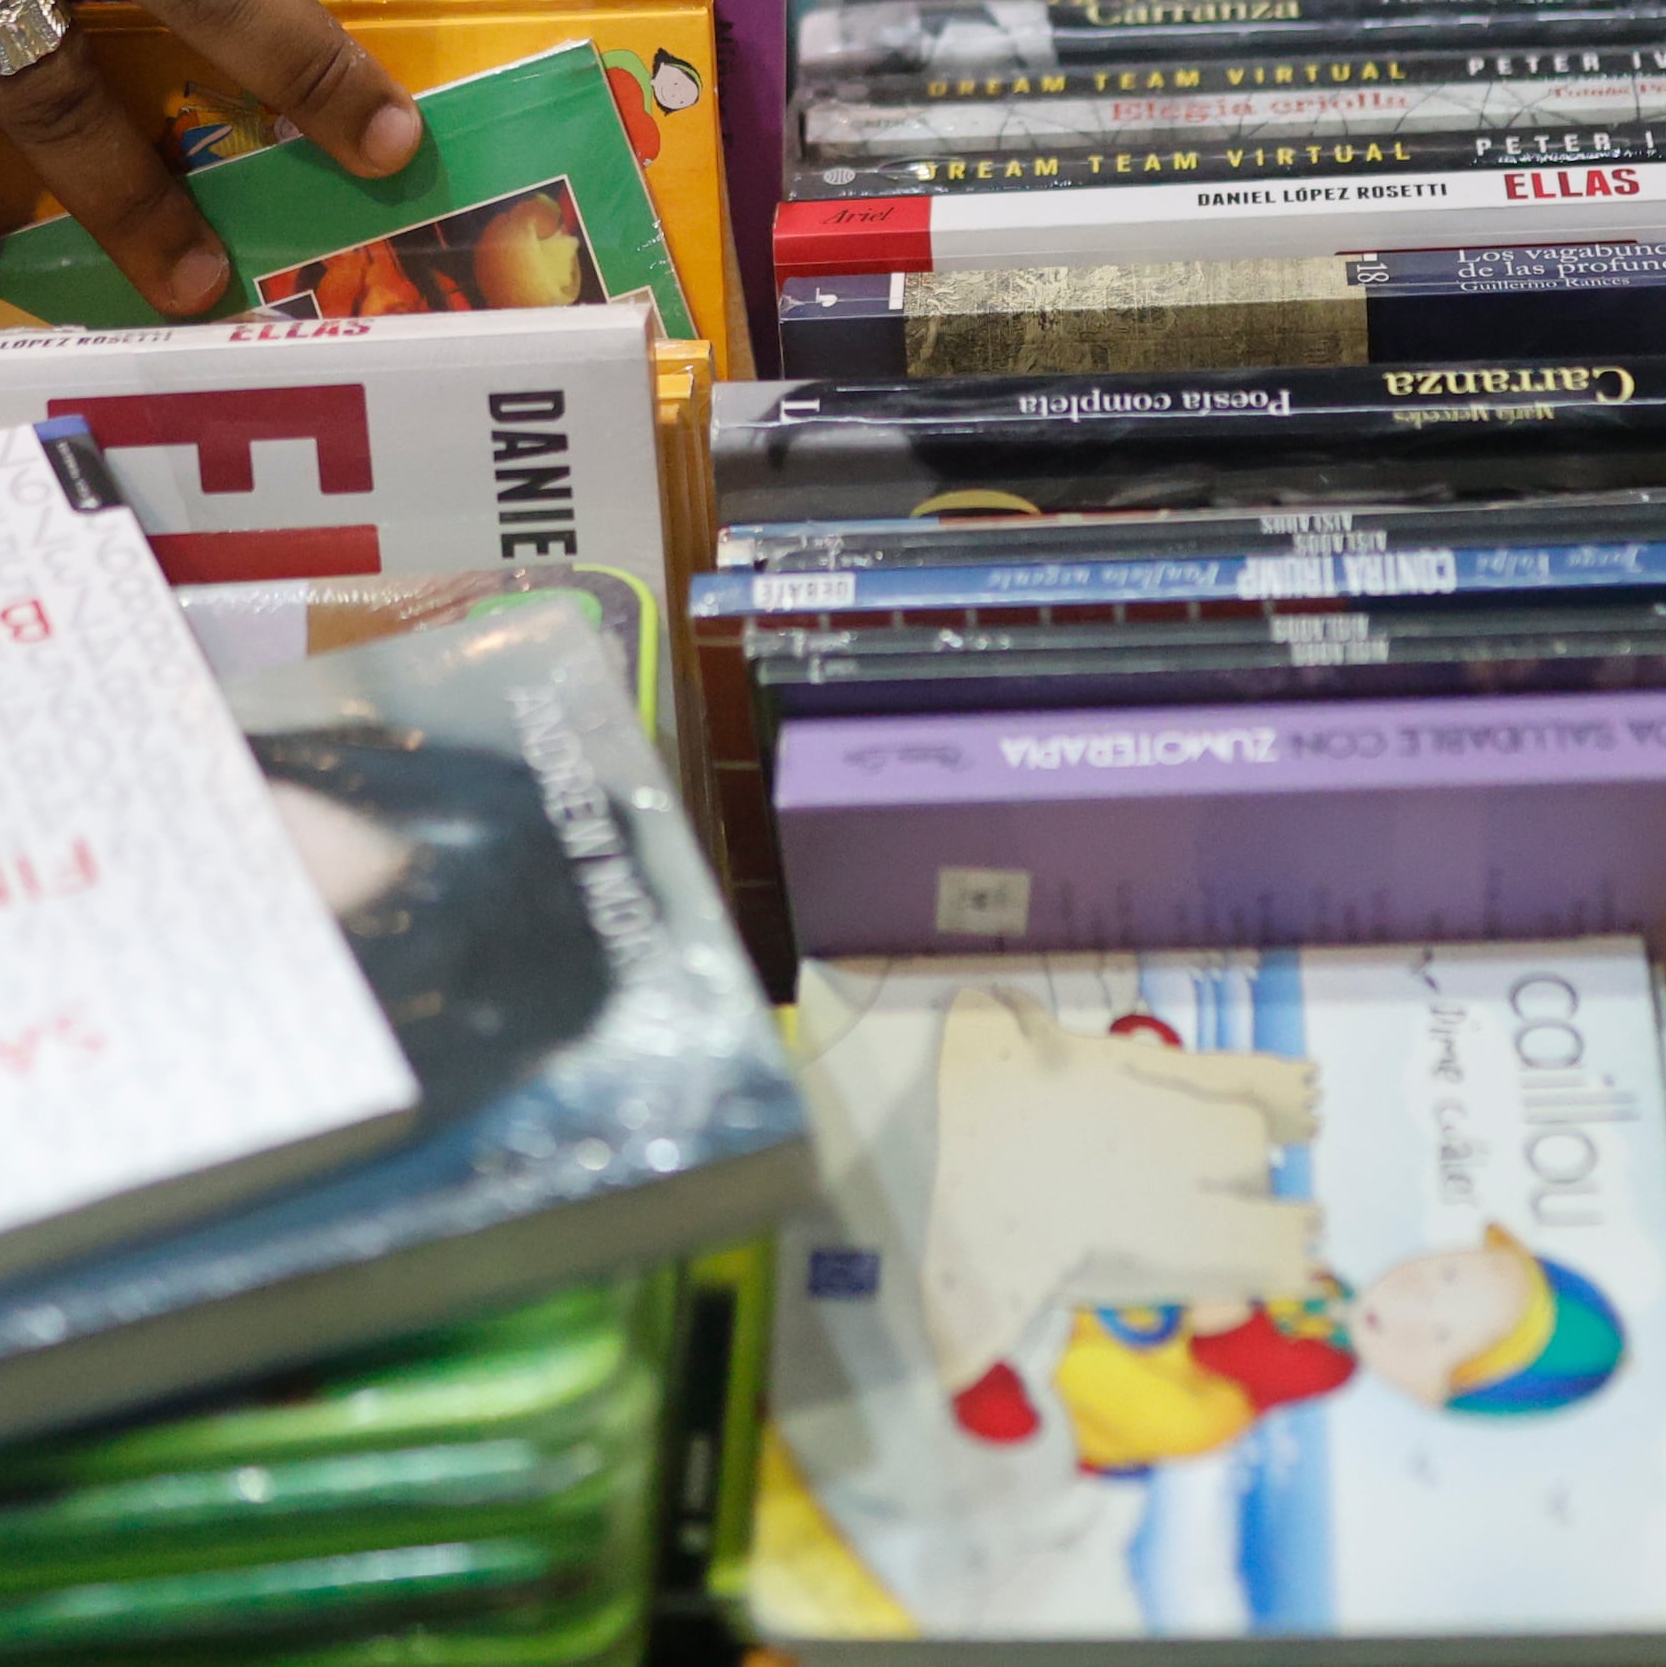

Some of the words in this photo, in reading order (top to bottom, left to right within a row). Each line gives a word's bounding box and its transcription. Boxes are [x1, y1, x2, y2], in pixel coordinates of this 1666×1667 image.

[927, 76, 1067, 98] DREAM
[1095, 68, 1202, 91] TEAM
[1227, 59, 1408, 86] VIRTUAL
[1467, 47, 1601, 77] PETER
[1088, 150, 1201, 175] TEAM
[1227, 138, 1412, 169] VIRTUAL
[1475, 131, 1613, 158] PETER
[822, 202, 896, 228] Ariel
[1197, 188, 1276, 209] DANIEL
[1283, 181, 1351, 205] LÓPEZ
[1357, 180, 1448, 201] ROSETTI
[1504, 167, 1641, 201] ELLAS
[1456, 248, 1520, 265] Los
[1457, 260, 1498, 280] de
[1504, 259, 1546, 278] las
[0, 334, 70, 352] LÓPEZ
[229, 318, 374, 343] ELLAS
[1019, 387, 1174, 424] completa
[1182, 388, 1293, 418] Poesía
[1383, 365, 1636, 405] Carranza
[487, 388, 579, 560] DANIE
[1236, 555, 1337, 600] TRUMP
[1343, 547, 1458, 597] CONTRA
[998, 728, 1281, 768] ZUMOTERAPIA
[1293, 723, 1390, 761] CON
[1397, 718, 1620, 758] SALUDABLE
[1429, 1004, 1483, 1086] Dime
[1505, 971, 1643, 1230] caillou
